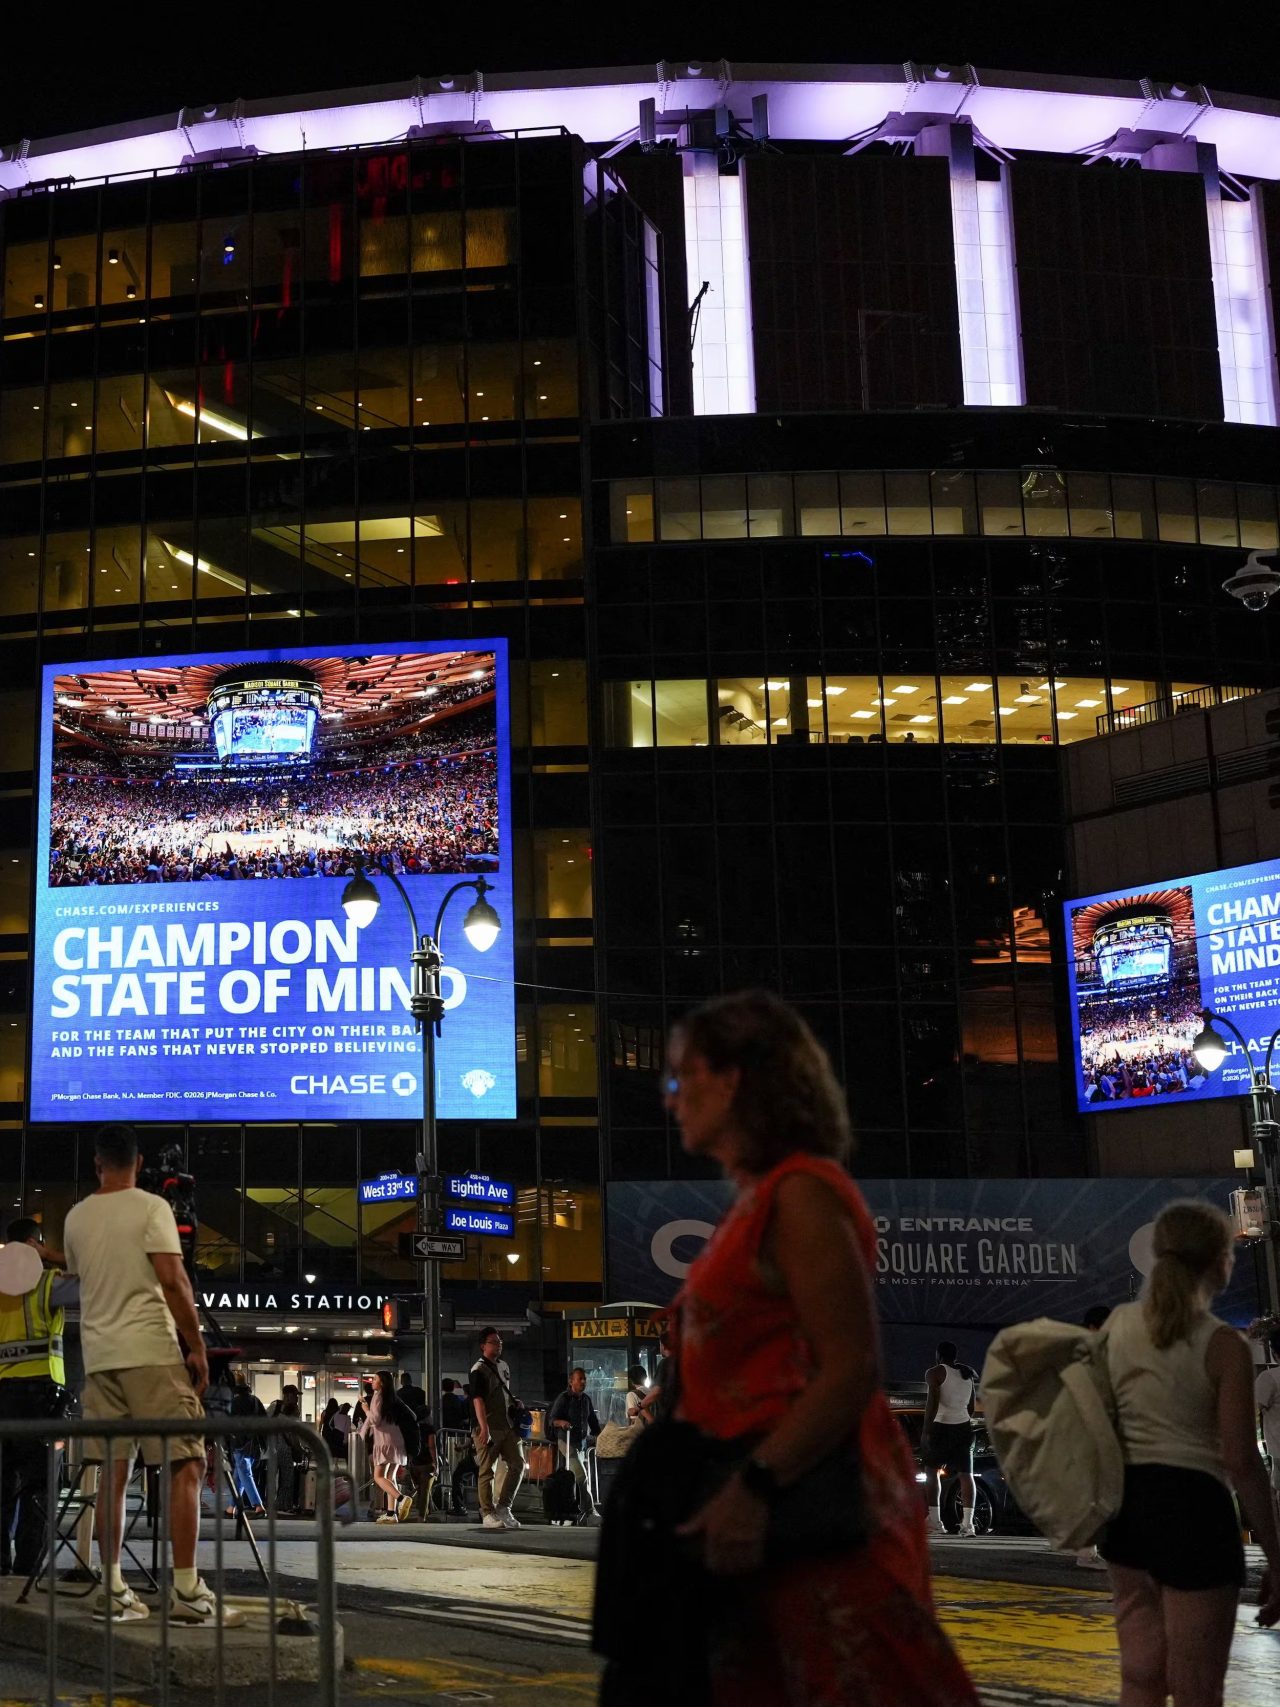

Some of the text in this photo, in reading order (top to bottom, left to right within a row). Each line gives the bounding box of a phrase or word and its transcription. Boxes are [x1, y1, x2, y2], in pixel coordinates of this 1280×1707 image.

[56, 902, 218, 916] CHASE.COM/EXPERIENCES
[1209, 918, 1280, 951] STATE
[53, 919, 357, 970] CHAMPION
[1211, 944, 1280, 976] MIND
[51, 966, 468, 1018] STATE OF MIND
[1214, 985, 1230, 994] FOR
[1232, 981, 1247, 991] THE
[1250, 977, 1272, 987] TEAM
[1231, 992, 1254, 1001] THEIR
[1256, 989, 1278, 998] BACK
[1216, 1005, 1237, 1014] THAT
[1239, 1001, 1266, 1011] NEVER
[52, 1031, 79, 1041] FOR
[85, 1030, 110, 1040] THE
[116, 1029, 155, 1040] TEAM
[161, 1028, 199, 1039] THAT
[206, 1028, 233, 1038] PUT
[239, 1027, 266, 1037] THE
[273, 1026, 306, 1037] CITY
[312, 1026, 334, 1036] ON
[341, 1026, 386, 1036] THEIR
[51, 1041, 421, 1057] AND THE FANS THAT NEVER STOPPED BELIEVING.
[291, 1075, 386, 1094] CHASE
[363, 1185, 385, 1198] West
[404, 1181, 415, 1194] St
[451, 1180, 508, 1198] Eighth Ave
[451, 1214, 508, 1231] Joe Louis Plaza
[899, 1217, 1033, 1232] ENTRANCE
[421, 1242, 457, 1253] ONE WAY
[875, 1239, 1078, 1275] SQUARE GARDEN
[891, 1279, 926, 1287] MOST
[931, 1279, 981, 1287] FAMOUS
[574, 1320, 609, 1337] TAXI
